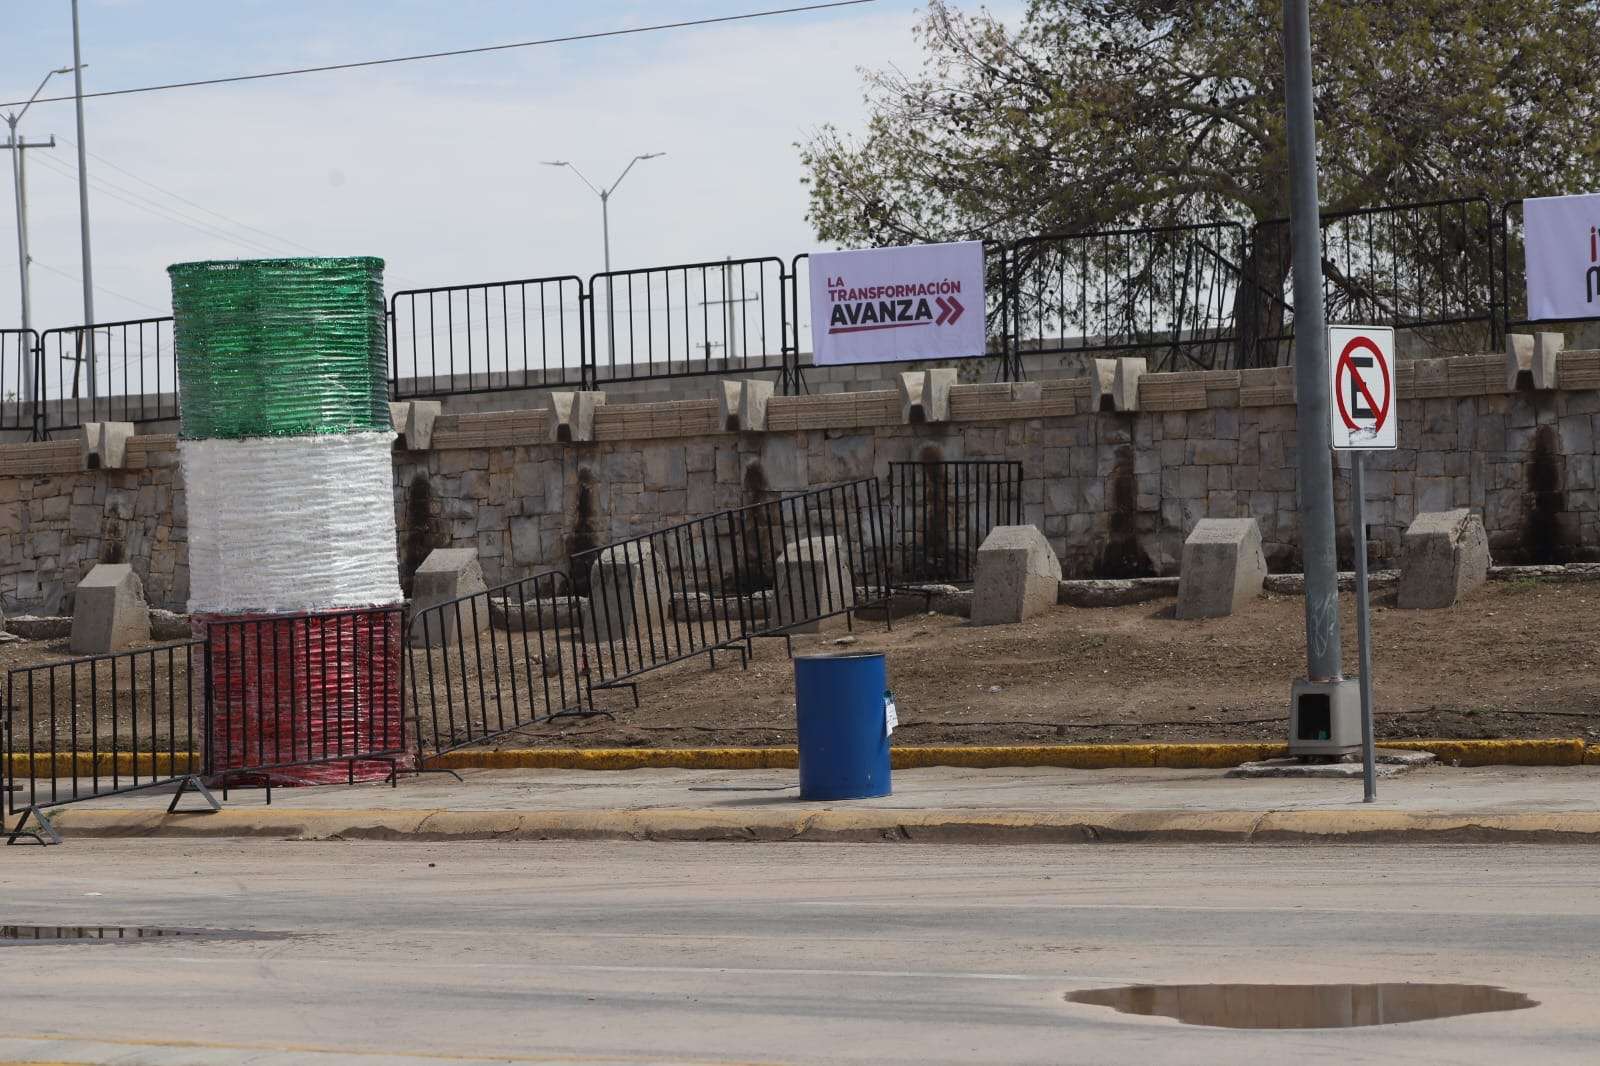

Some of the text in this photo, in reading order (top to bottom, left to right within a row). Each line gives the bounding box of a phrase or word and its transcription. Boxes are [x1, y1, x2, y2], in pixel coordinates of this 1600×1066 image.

[827, 276, 845, 288] LA
[828, 278, 961, 302] TRANSFORMACIÓN
[830, 298, 934, 326] AVANZA
